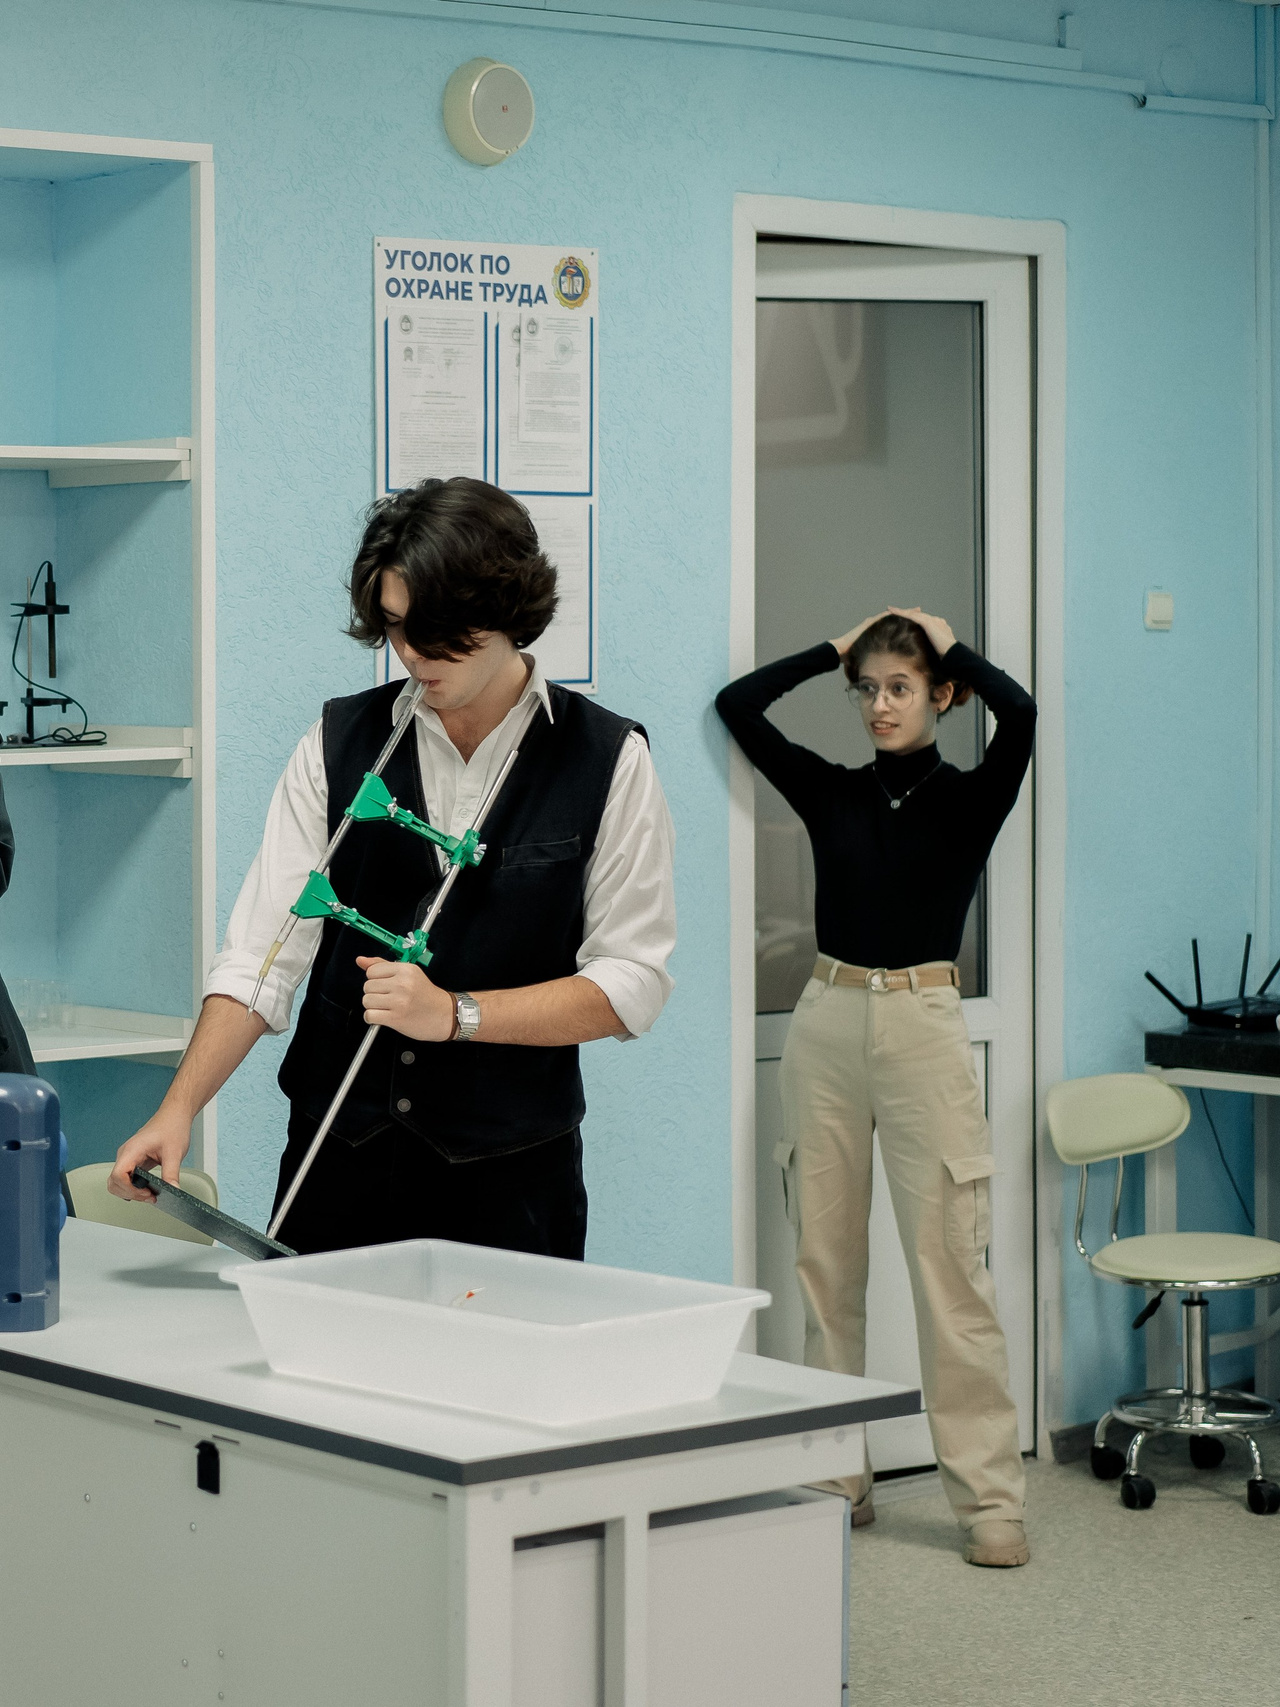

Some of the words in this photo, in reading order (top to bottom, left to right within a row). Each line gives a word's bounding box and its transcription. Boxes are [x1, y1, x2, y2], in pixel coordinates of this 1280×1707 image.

[384, 249, 474, 274] УГОЛОК
[480, 254, 510, 275] ПО
[385, 277, 473, 301] ОХРАНЕ
[479, 282, 548, 307] ТРУДА
